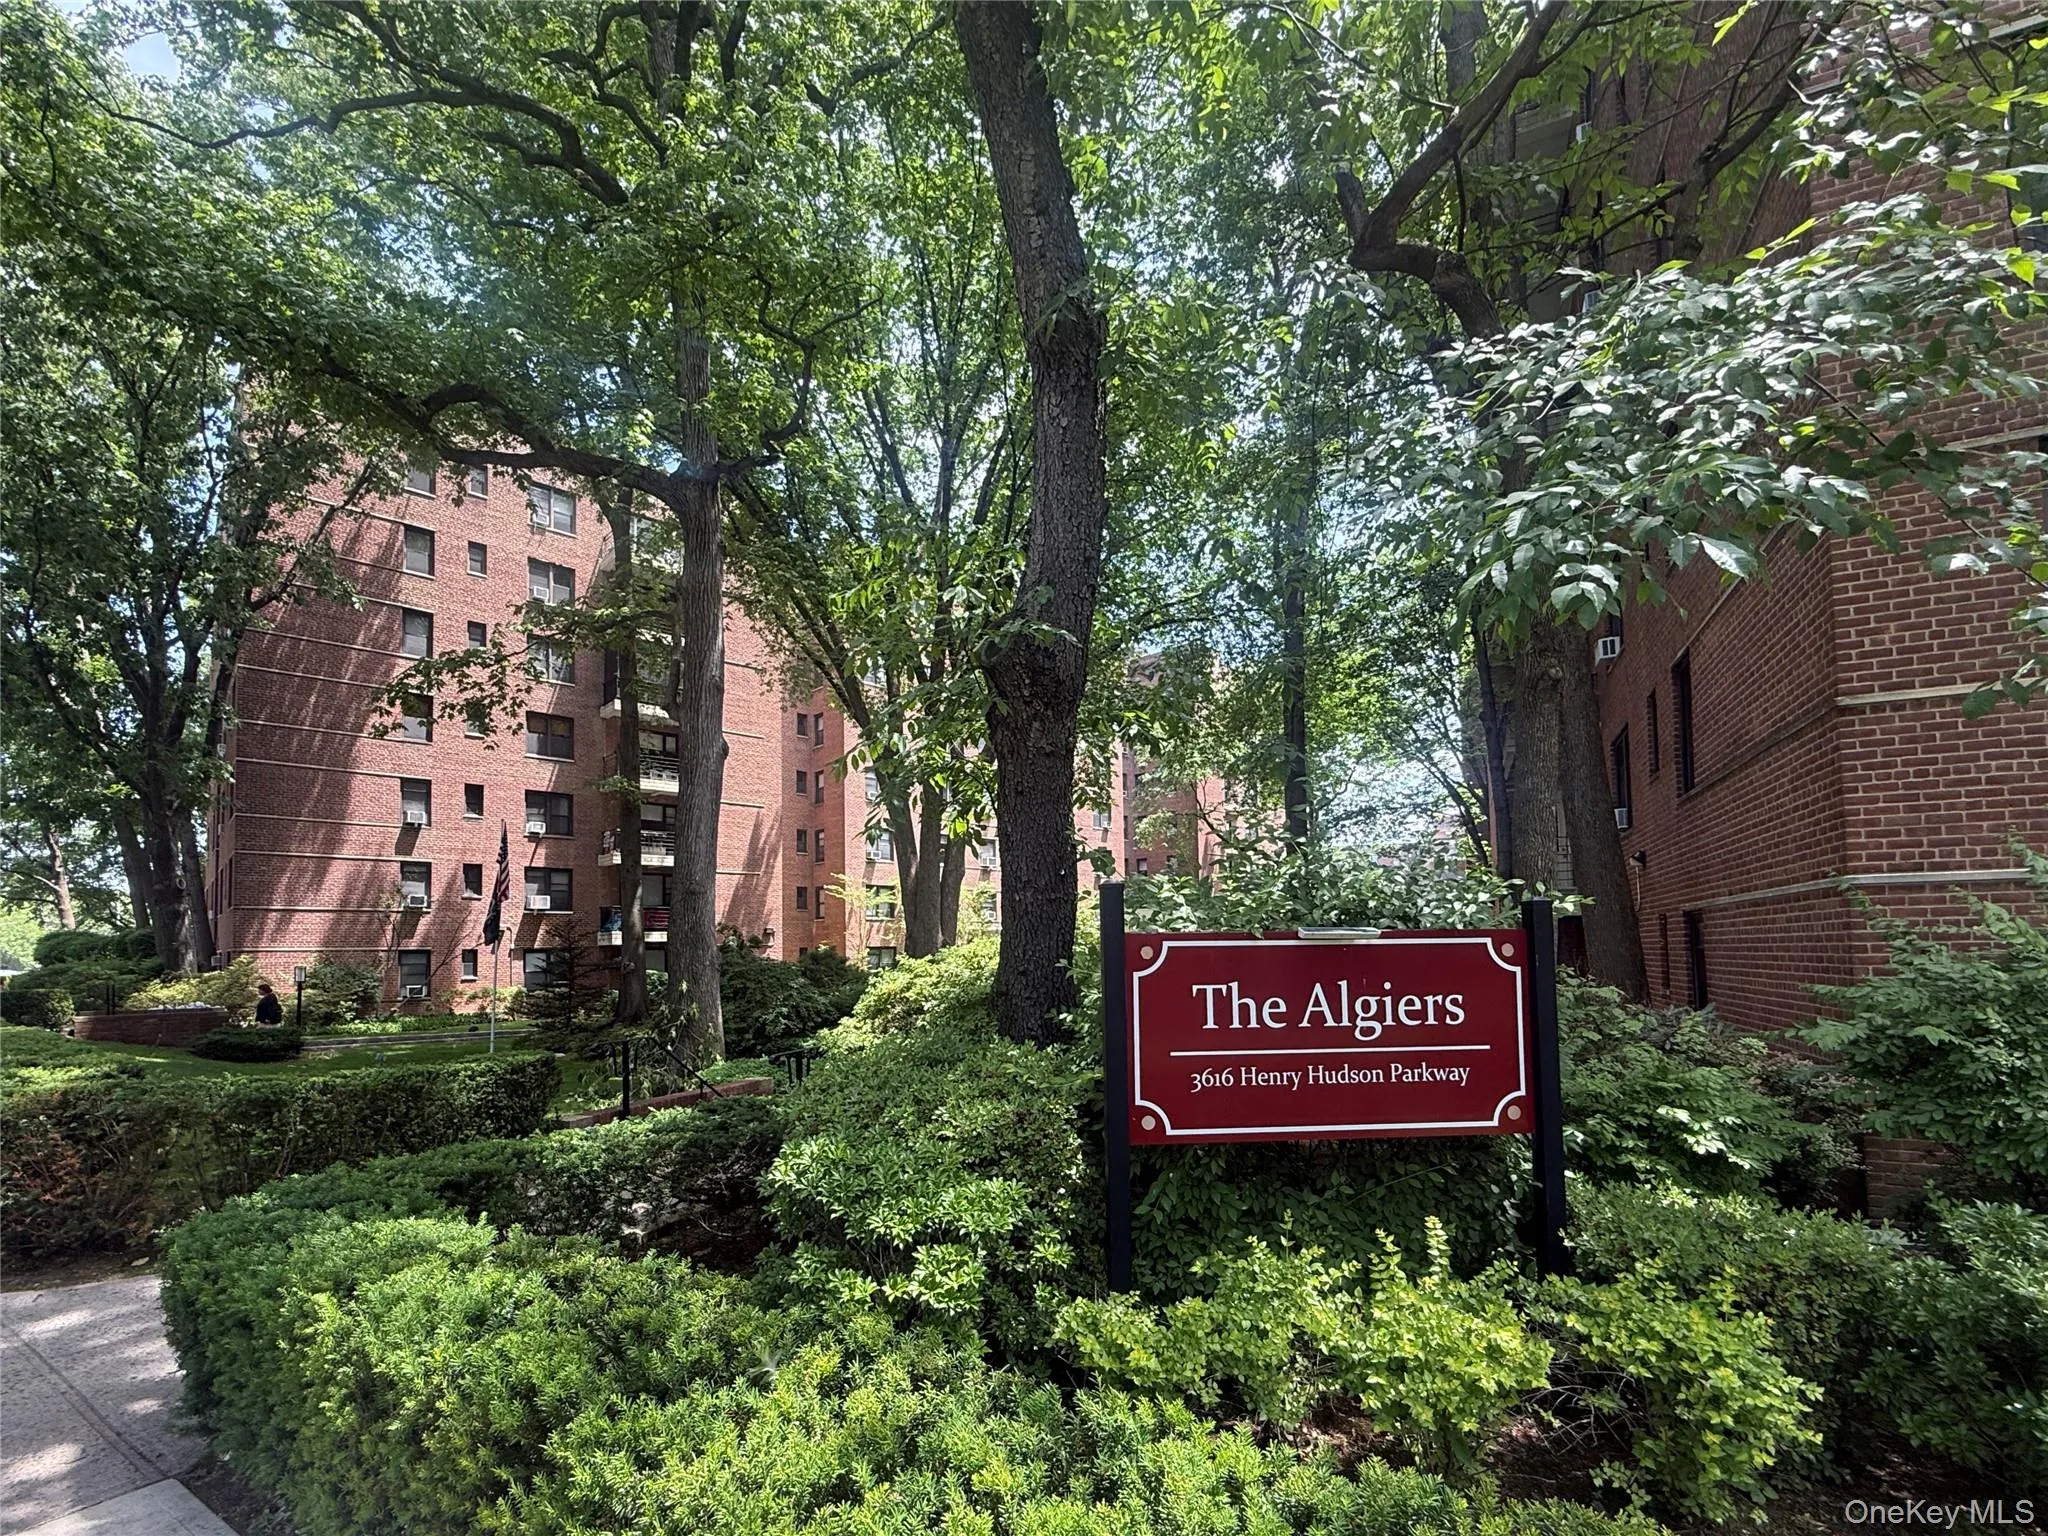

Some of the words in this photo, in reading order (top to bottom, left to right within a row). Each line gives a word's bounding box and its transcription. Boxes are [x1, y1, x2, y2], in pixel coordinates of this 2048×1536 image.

[1192, 981, 1287, 1030] The
[1298, 979, 1466, 1041] Algiers
[1190, 1066, 1234, 1093] 3616
[1240, 1066, 1302, 1091] Henry
[1307, 1063, 1384, 1085] Hudson
[1389, 1063, 1471, 1088] Parkway
